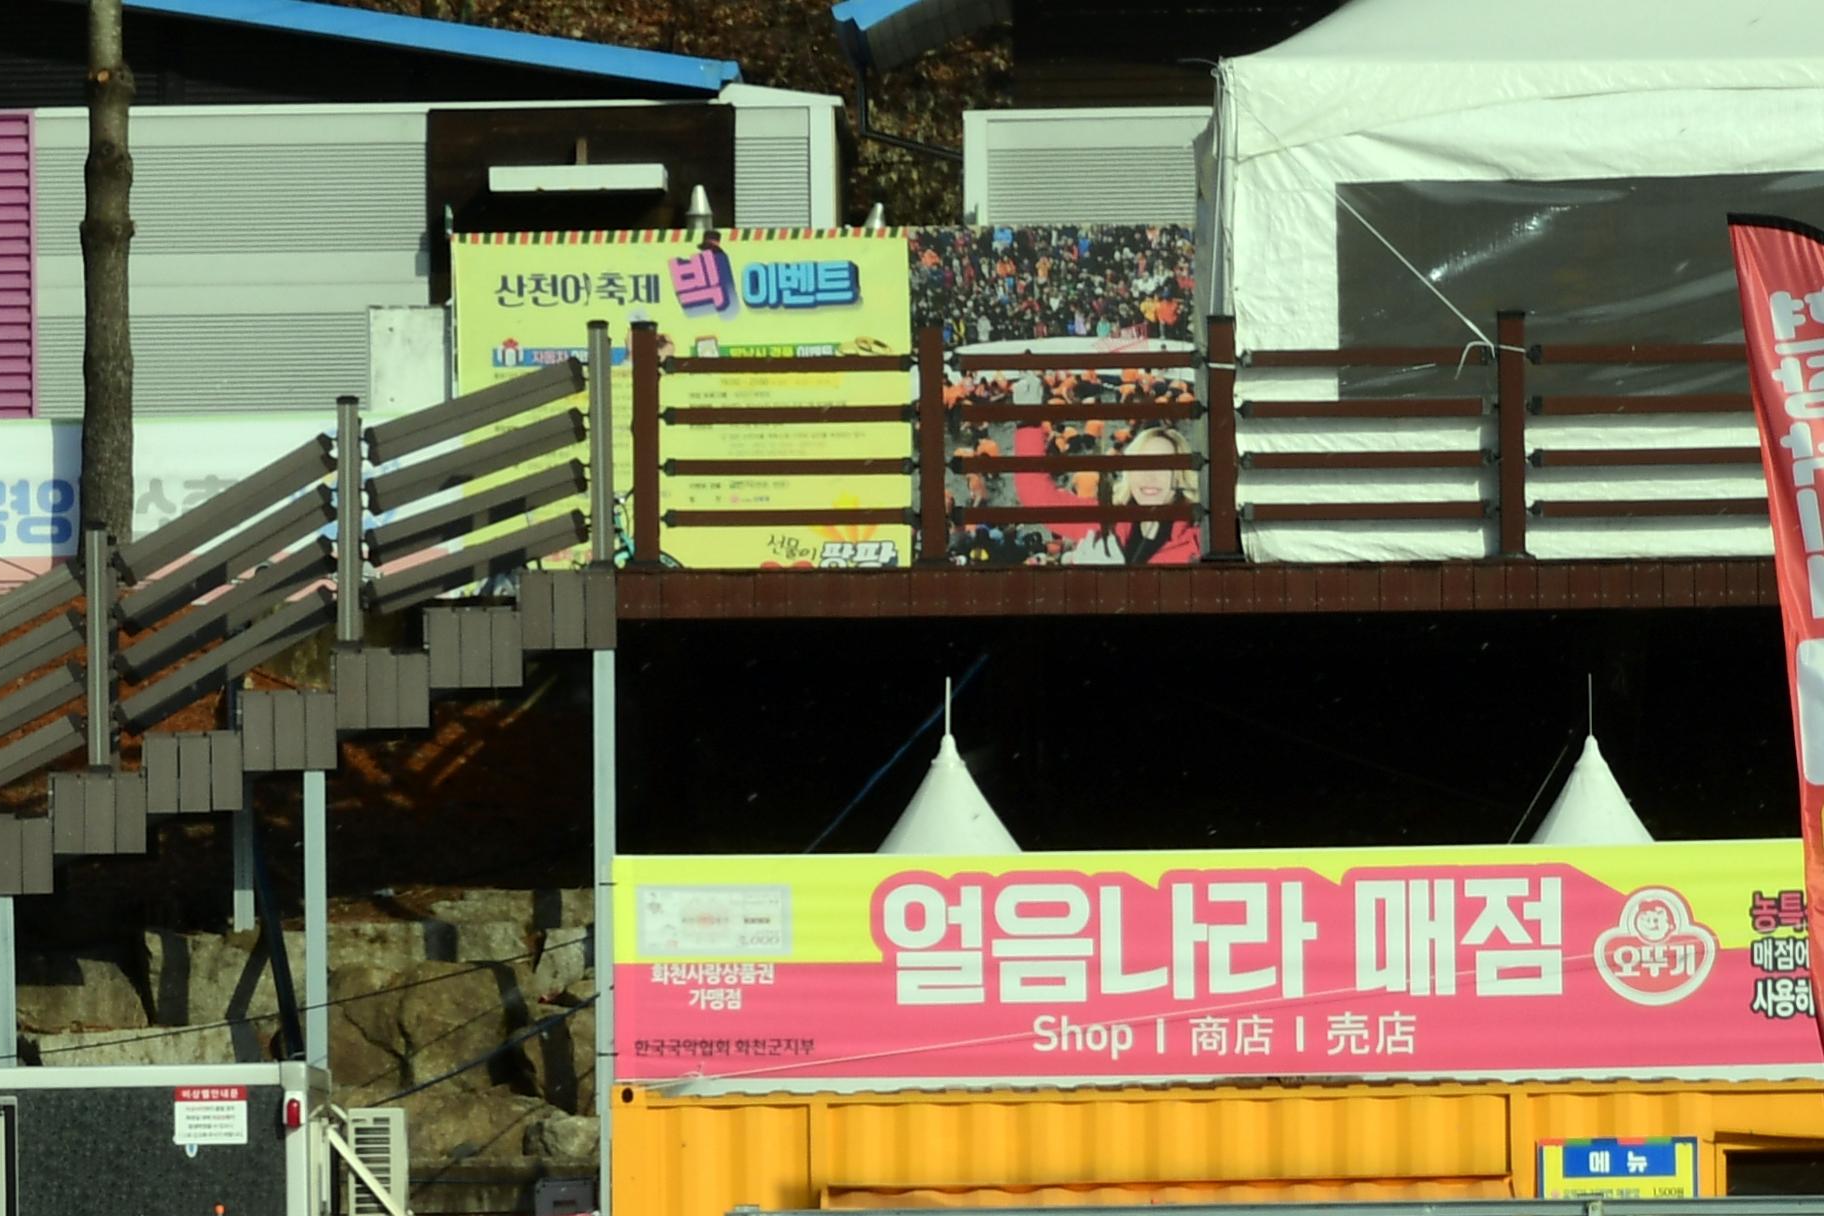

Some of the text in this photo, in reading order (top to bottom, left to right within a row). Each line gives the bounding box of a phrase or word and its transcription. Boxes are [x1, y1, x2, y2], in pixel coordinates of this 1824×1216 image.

[667, 248, 725, 310] 빅
[740, 259, 856, 309] 이벤트
[1751, 891, 1808, 932] 농특
[881, 876, 1564, 1006] 얼음나라 매점
[1612, 944, 1698, 979] 오뚜기
[650, 963, 776, 987] 화천사랑상품권
[687, 987, 743, 1011] 가맹점
[634, 1037, 815, 1057] 한국국악협회 화천군지부
[1031, 1014, 1134, 1061] Shop
[1189, 1015, 1274, 1057] 商店
[1325, 1011, 1417, 1056] 売店
